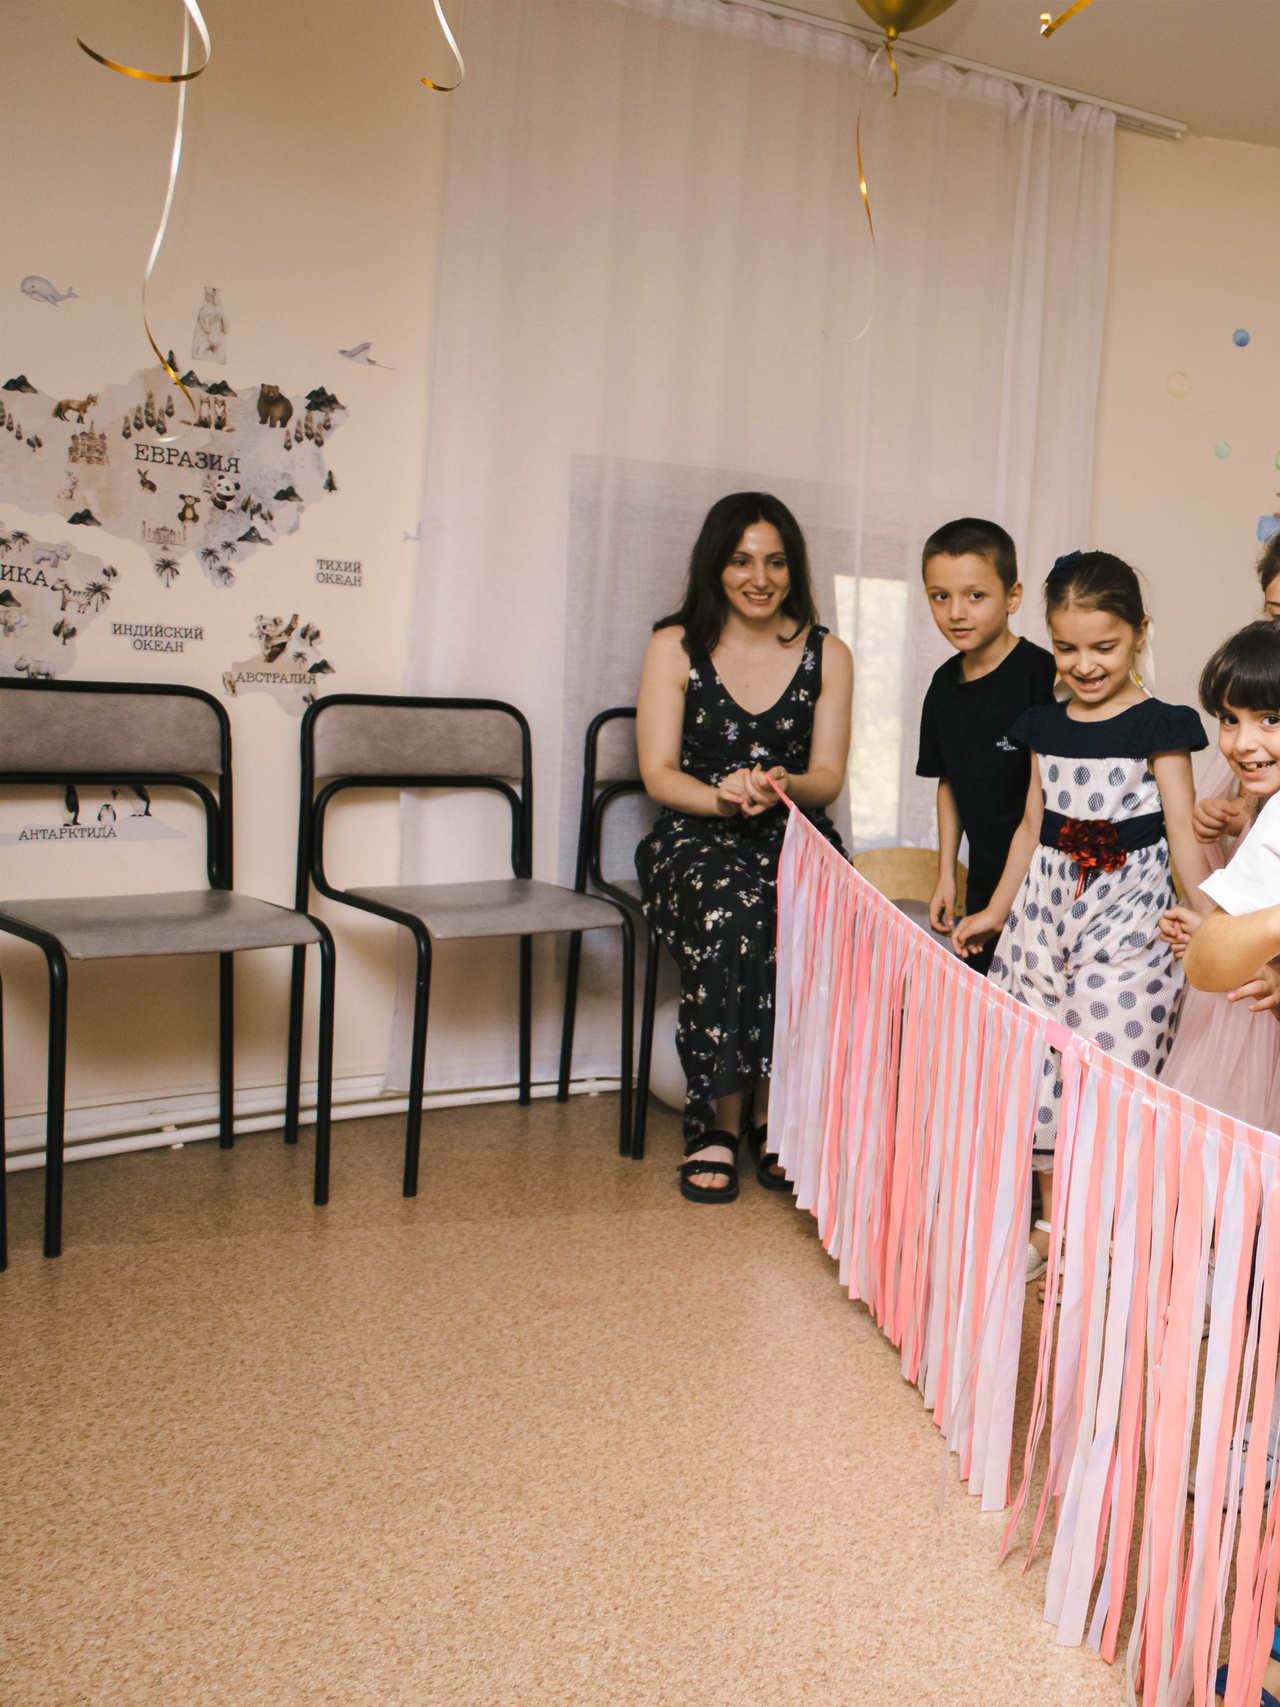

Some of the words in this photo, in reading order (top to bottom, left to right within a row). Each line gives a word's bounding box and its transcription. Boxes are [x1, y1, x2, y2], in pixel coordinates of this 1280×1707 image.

[134, 443, 241, 474] ЕВРАЗИЯ
[316, 558, 362, 573] ТИХИЙ
[0, 563, 50, 587] ИКА
[316, 572, 362, 587] ОКЕАН
[112, 623, 204, 640] ИНДИЙСКИЙ
[133, 638, 184, 653] ОКЕАН
[236, 671, 317, 685] АВСТРАЛИЯ
[18, 826, 117, 841] АНТАРКТИДА
